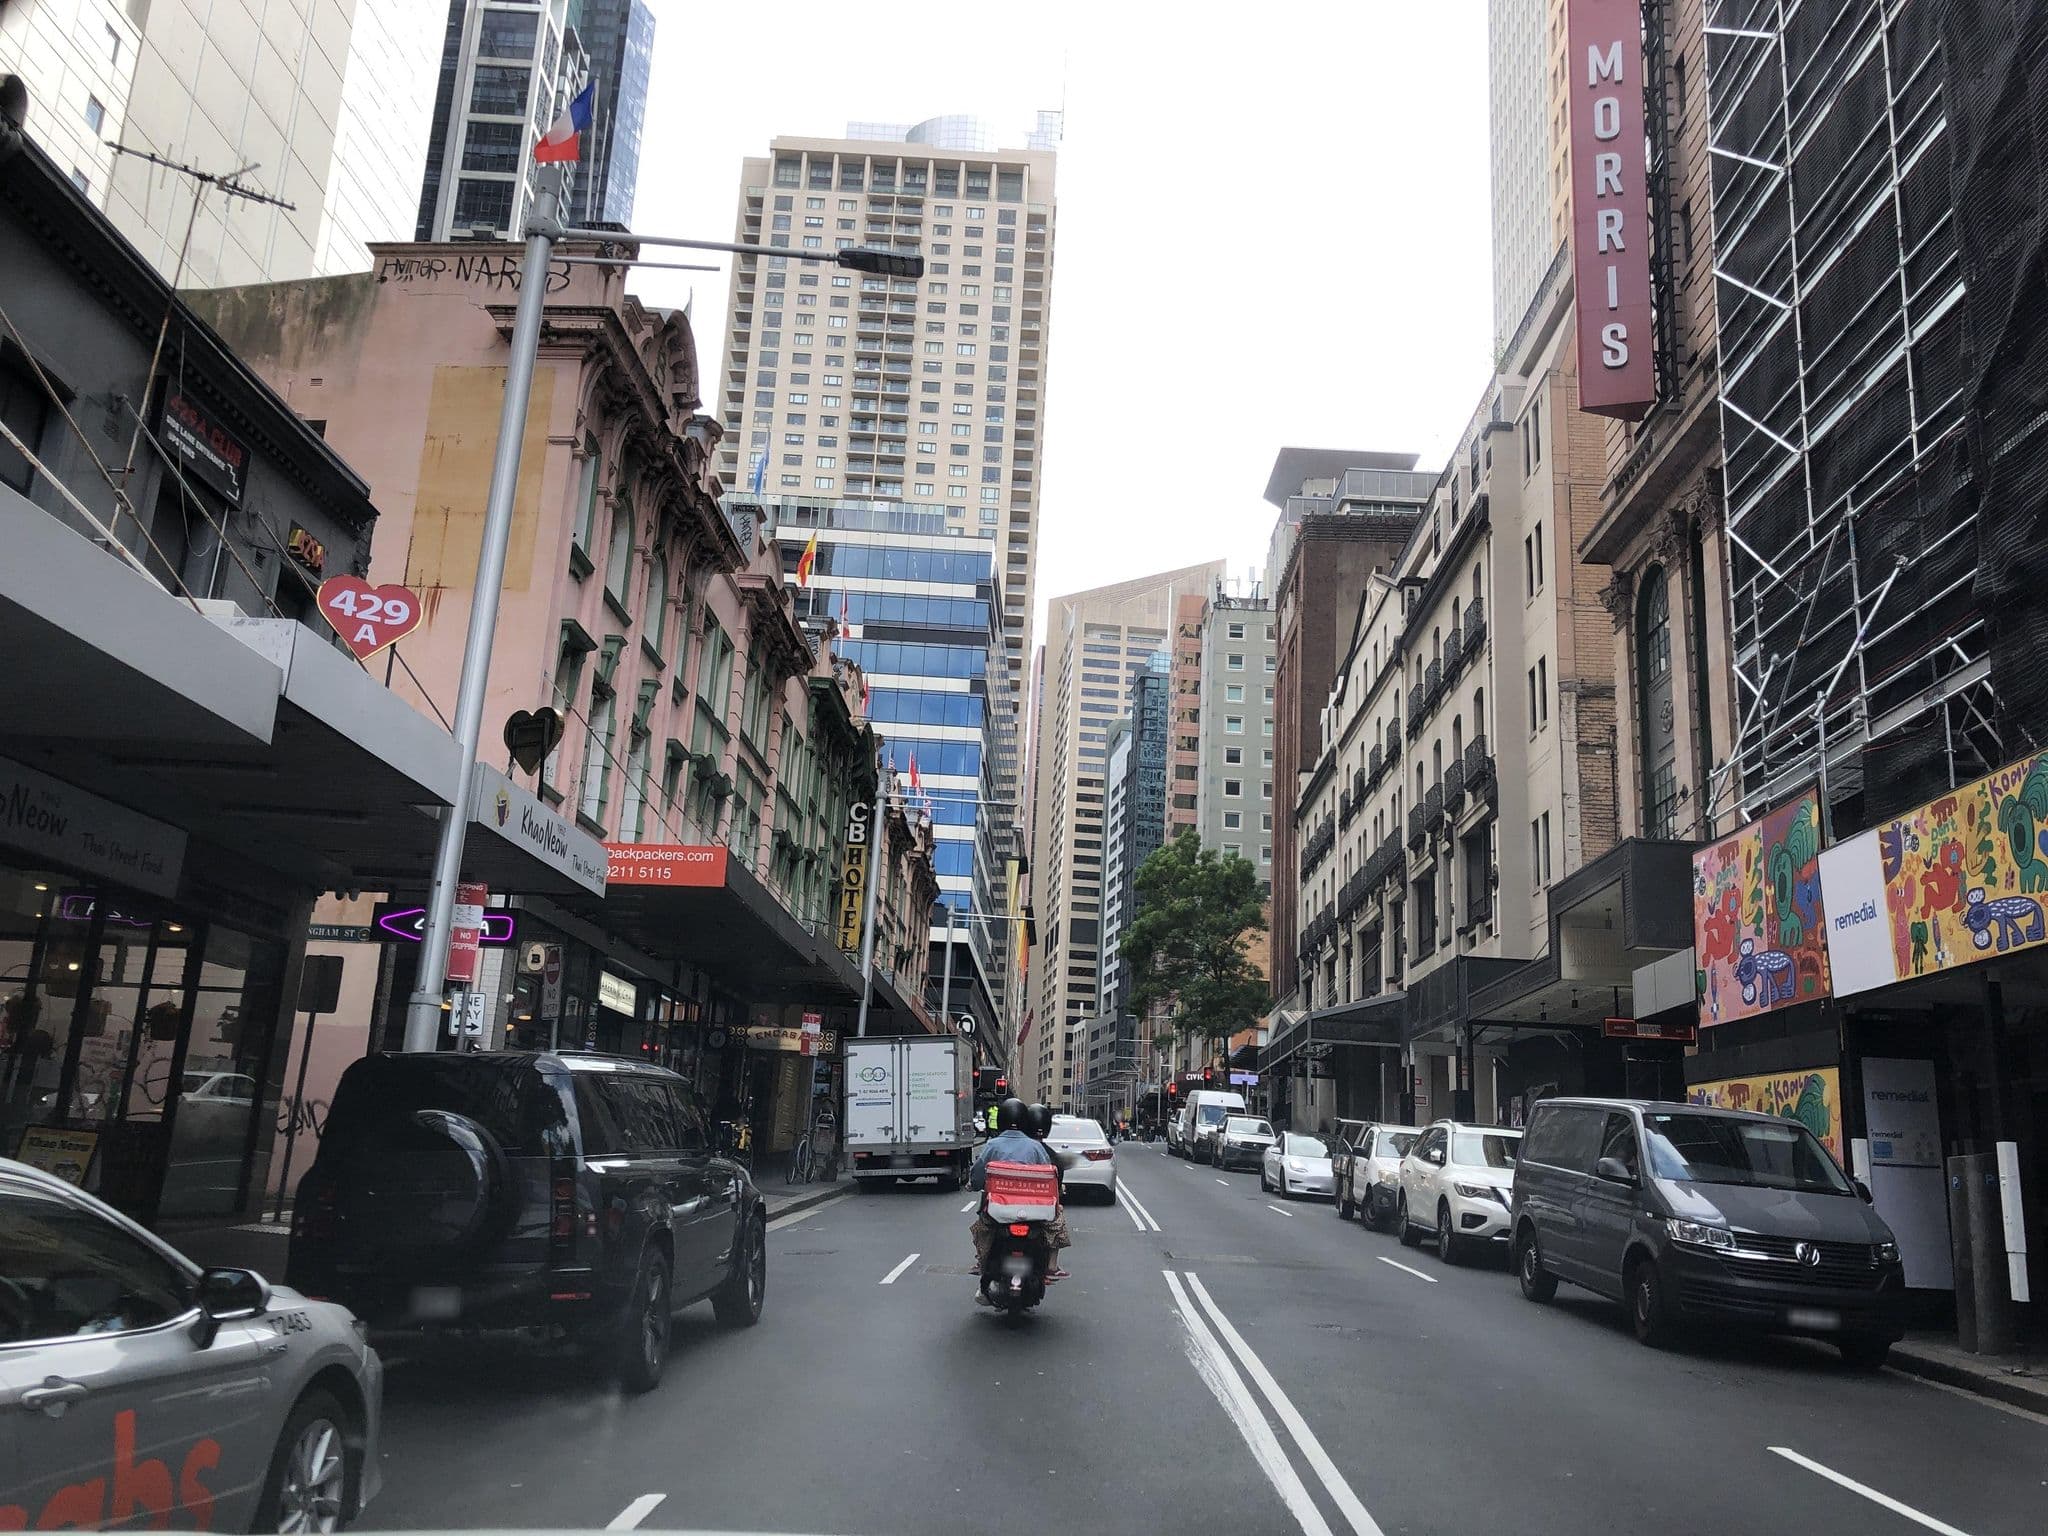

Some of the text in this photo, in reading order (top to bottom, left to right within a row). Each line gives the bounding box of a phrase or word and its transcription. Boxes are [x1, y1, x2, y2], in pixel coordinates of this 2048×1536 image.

[1587, 40, 1626, 369] MORRIS
[329, 589, 410, 625] 429
[353, 623, 377, 646] A
[638, 867, 672, 879] 5115
[842, 801, 868, 952] CB HOTEL
[1834, 898, 1878, 931] remedial
[344, 929, 356, 937] ST
[460, 931, 472, 940] NO
[451, 941, 479, 951] STOPPING
[1186, 1073, 1205, 1081] CIVIC
[1871, 1090, 1929, 1103] remedial
